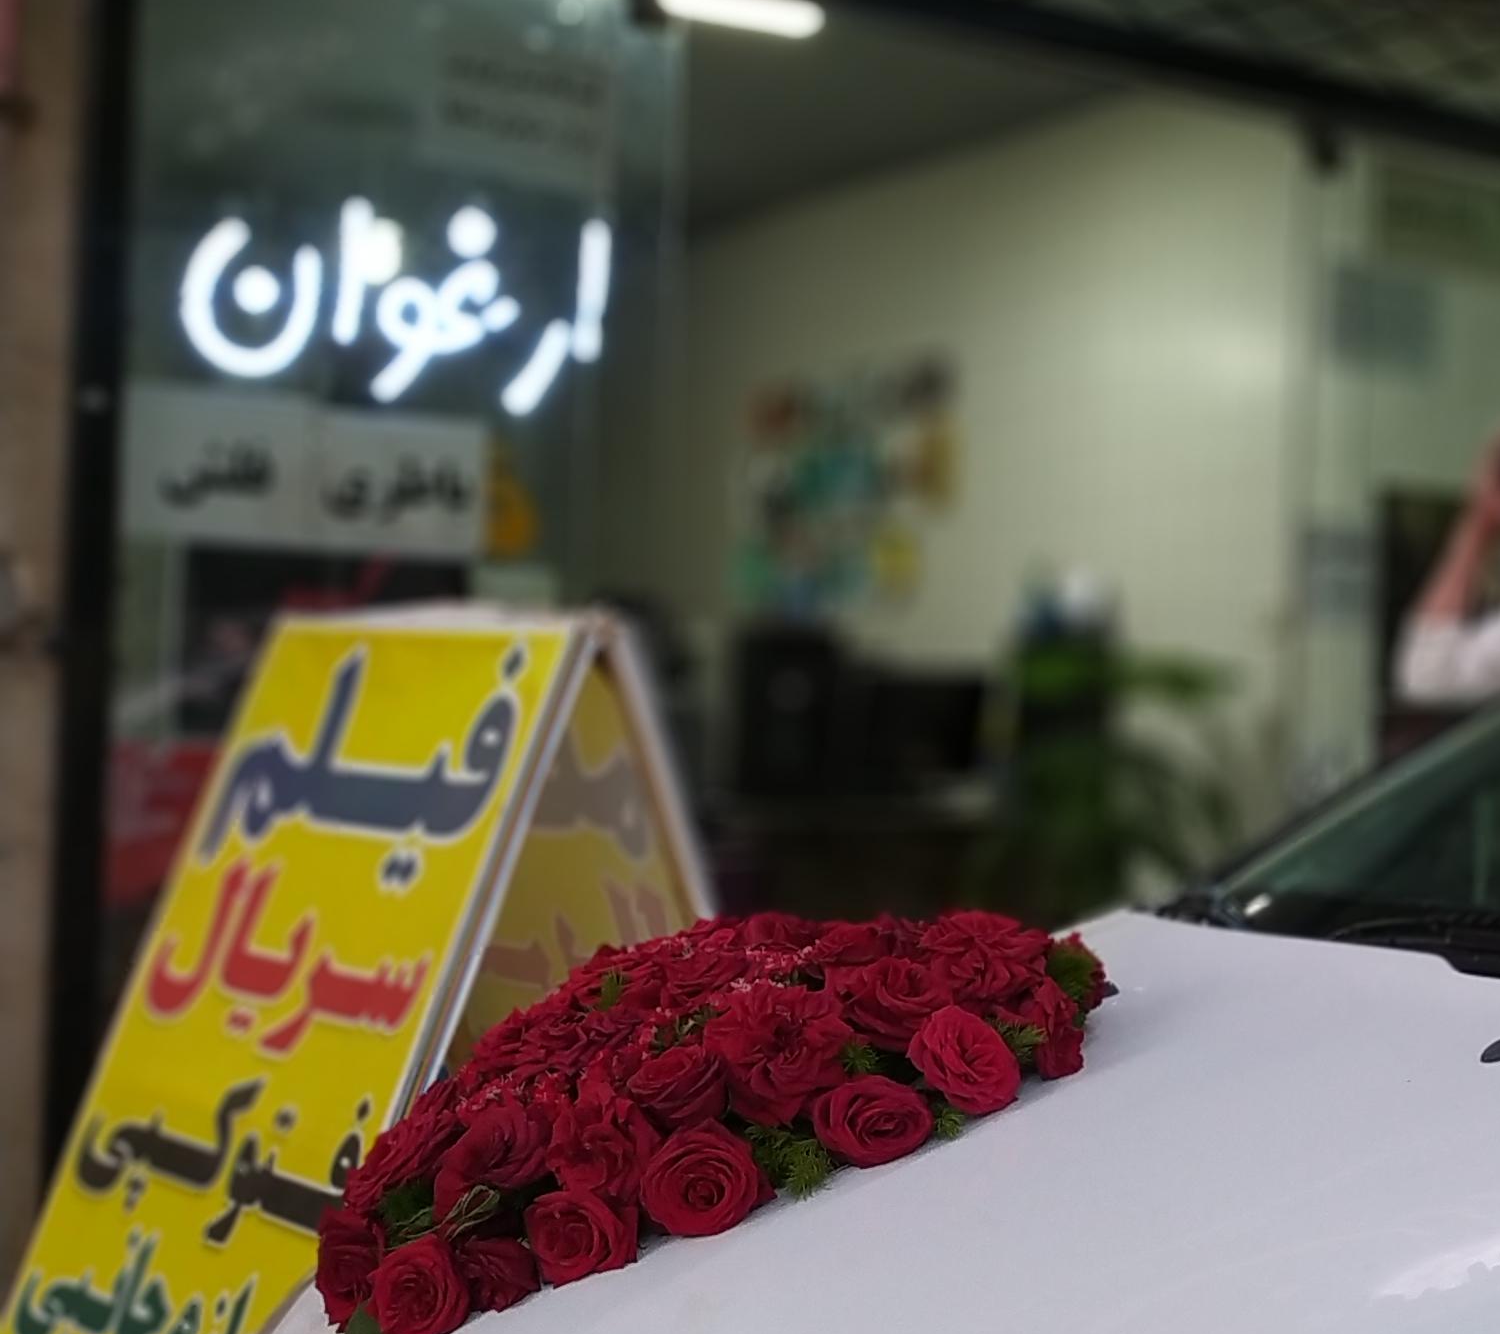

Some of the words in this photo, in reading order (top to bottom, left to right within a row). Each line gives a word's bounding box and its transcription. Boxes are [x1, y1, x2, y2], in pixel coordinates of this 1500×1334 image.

[177, 194, 614, 418] ارغوان
[200, 643, 528, 885] فیلم
[145, 859, 431, 1056] سریال
